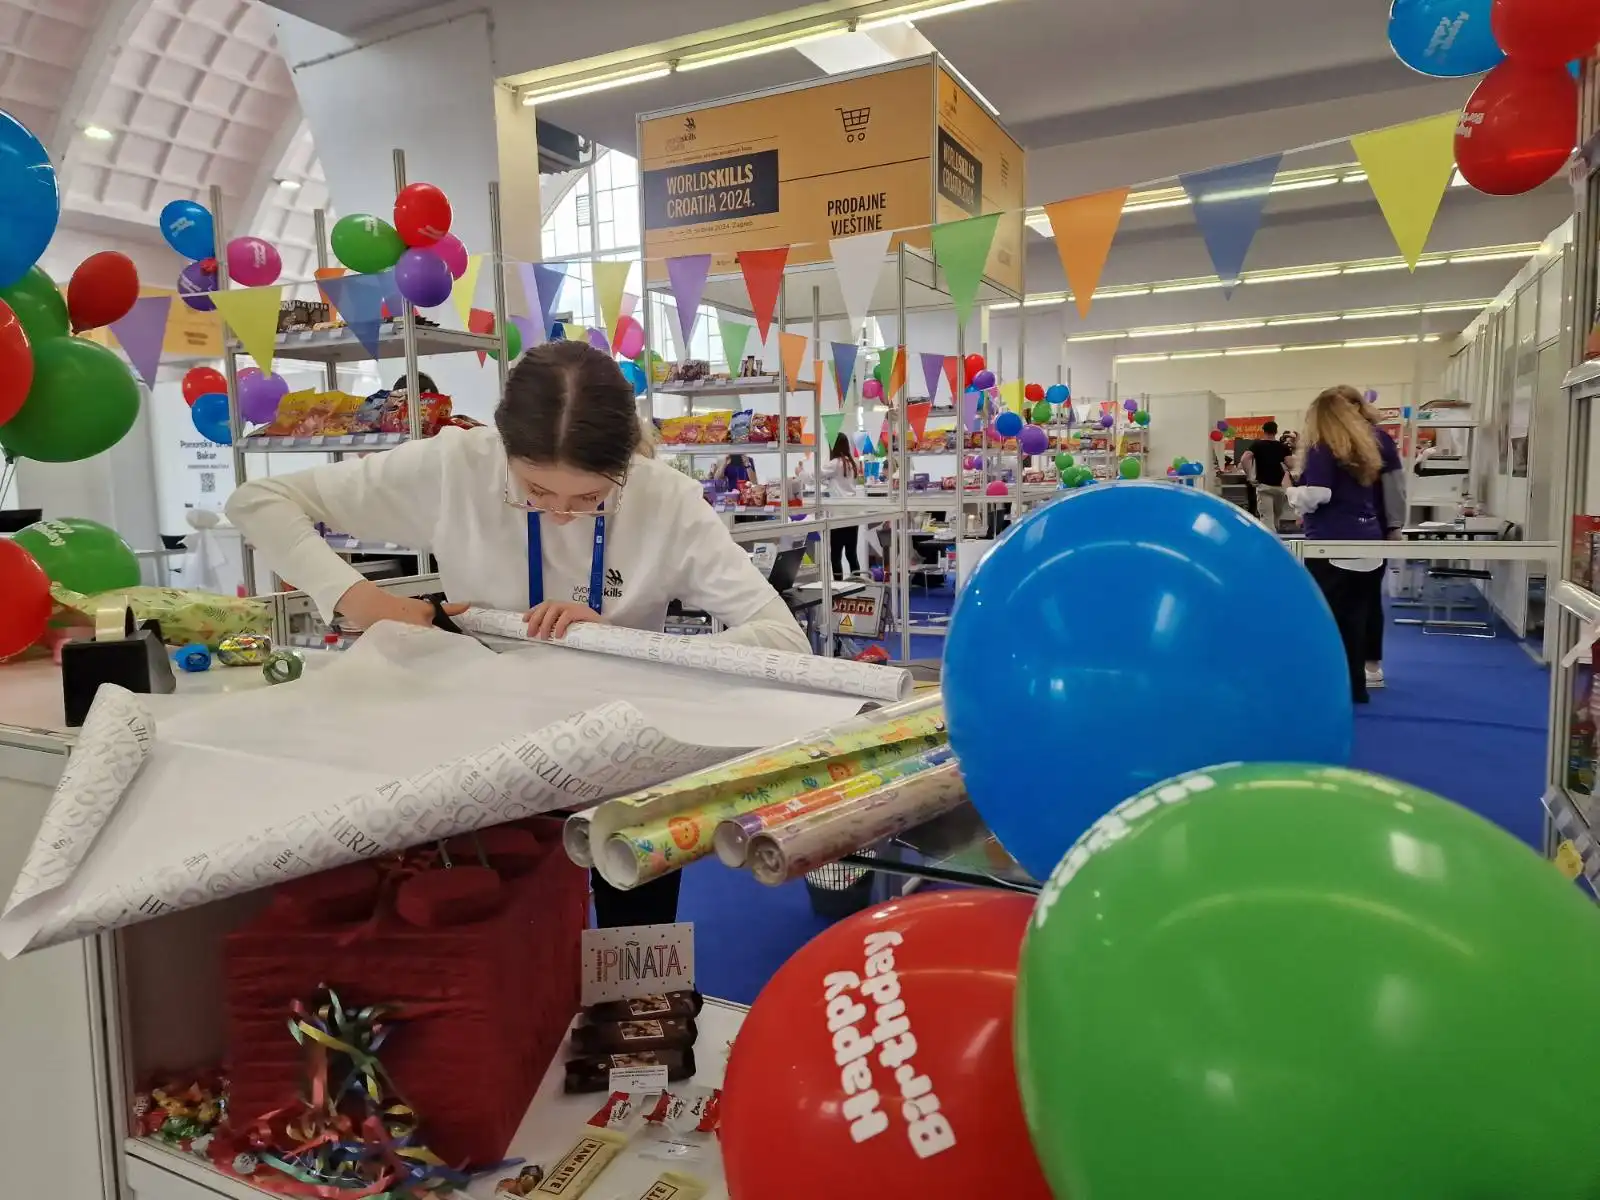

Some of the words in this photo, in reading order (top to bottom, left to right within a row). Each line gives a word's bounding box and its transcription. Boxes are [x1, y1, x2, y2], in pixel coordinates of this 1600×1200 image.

[666, 163, 754, 196] WORLDSKILLS
[667, 194, 717, 219] CROATIA
[719, 188, 756, 212] 2024.
[827, 192, 887, 217] PRODAJNE
[831, 214, 883, 237] VJEŠTINE
[603, 940, 682, 982] PIÑATA
[823, 970, 889, 1144] Happy
[860, 930, 957, 1159] Birthday
